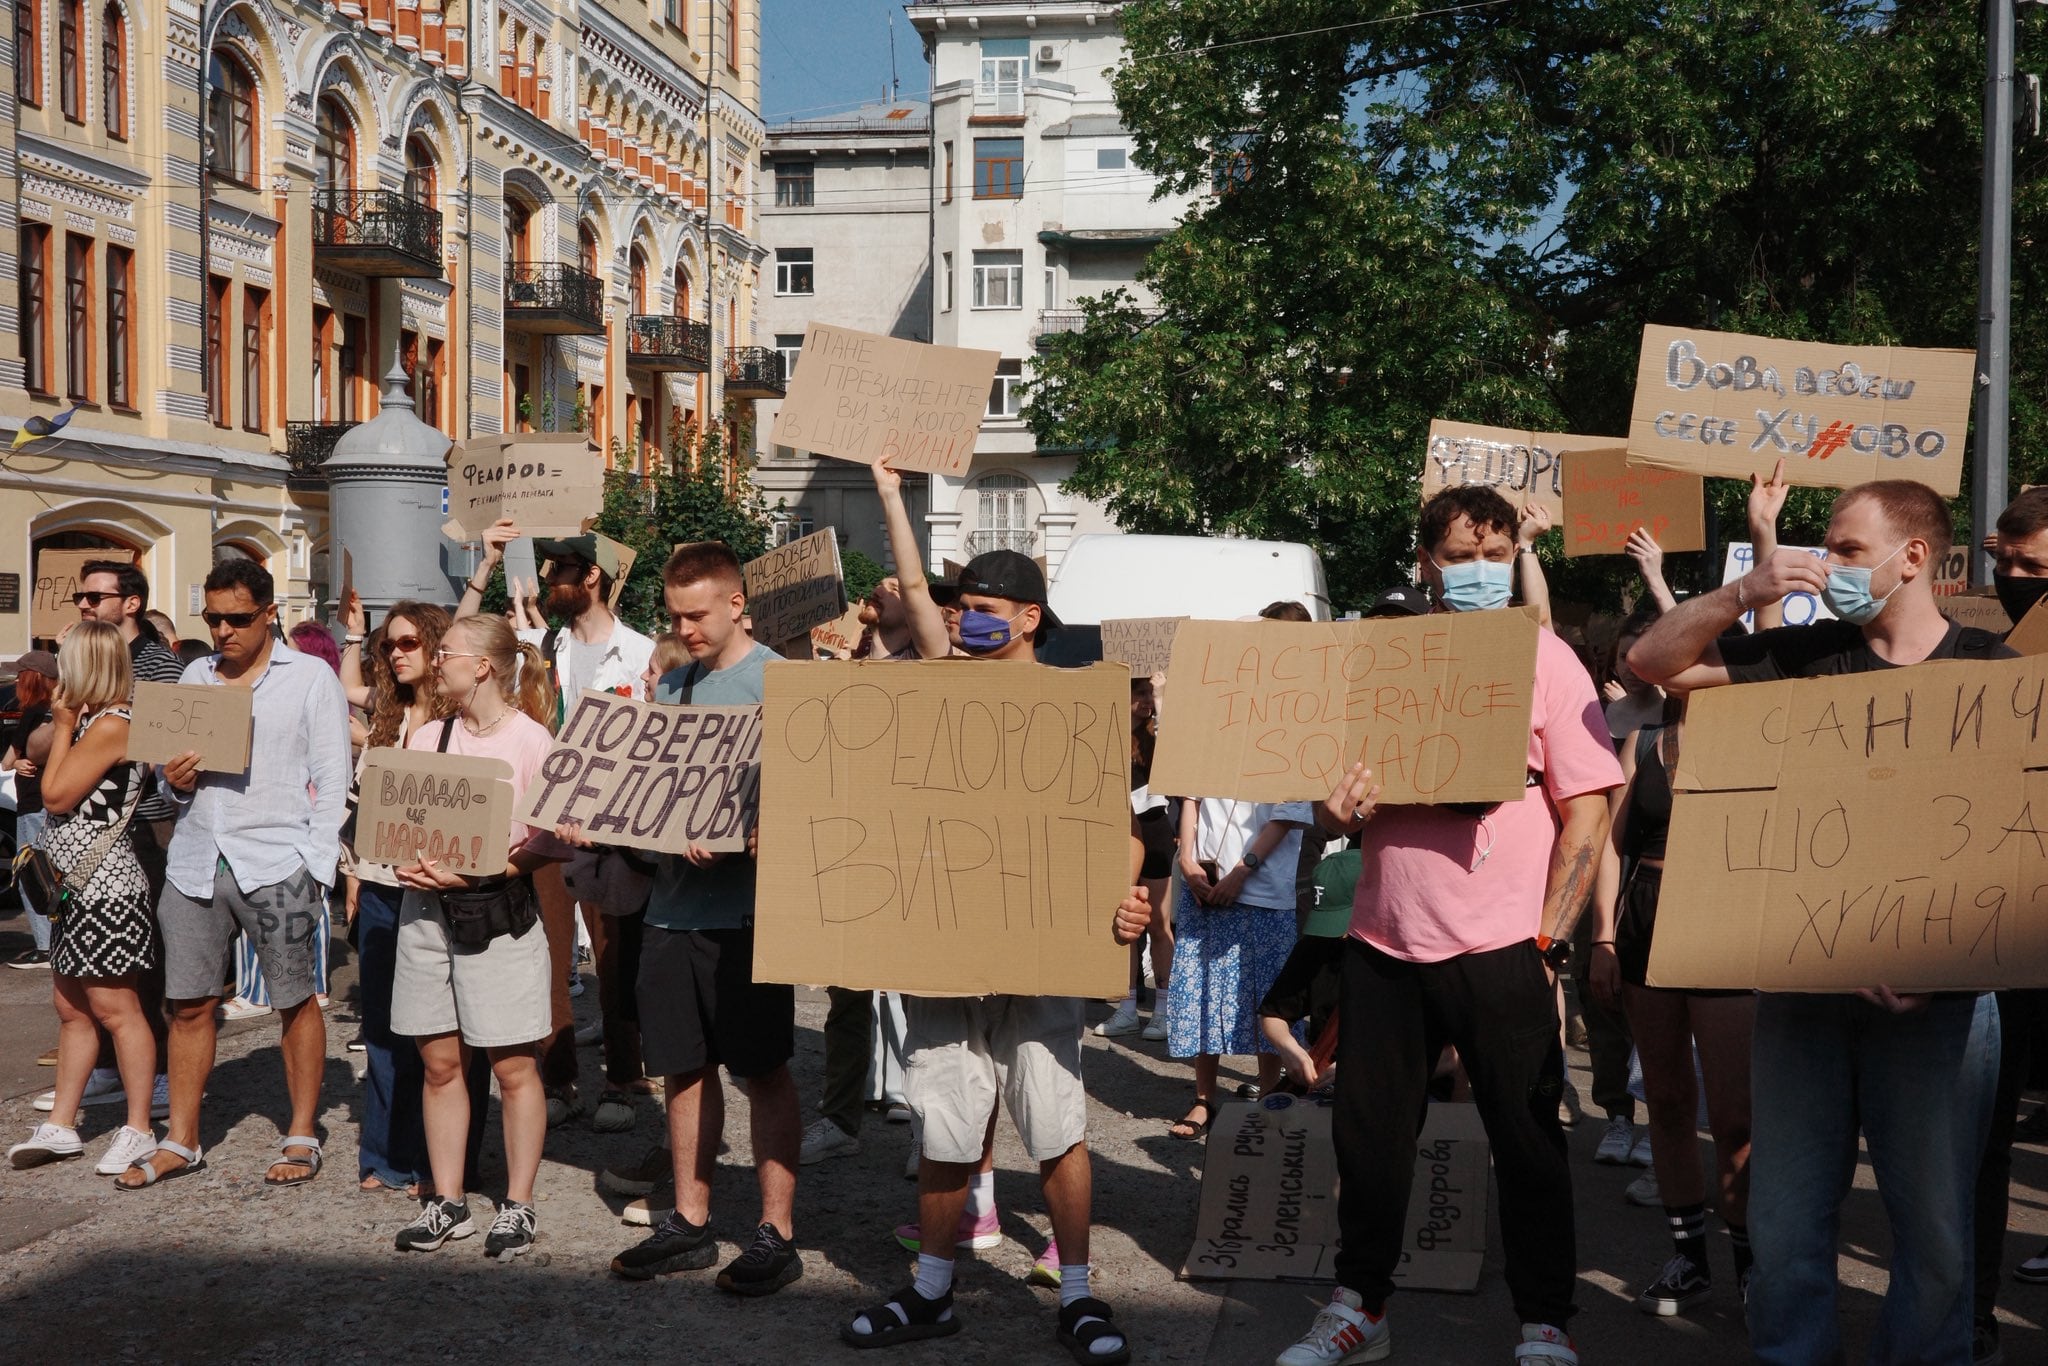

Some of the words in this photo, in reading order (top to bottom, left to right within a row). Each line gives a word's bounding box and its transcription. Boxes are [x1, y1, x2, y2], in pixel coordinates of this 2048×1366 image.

[811, 330, 877, 363] ПАНЕ
[782, 413, 800, 438] В
[811, 418, 869, 454] ЦІЙ
[881, 428, 974, 469] ВІЙНІ?
[837, 396, 868, 421] ВИ
[874, 405, 900, 425] ЗА
[913, 411, 966, 432] КОГО
[750, 557, 771, 585] НАС
[772, 535, 827, 574] ДОВЕЛИ
[1202, 633, 1460, 686] LACTOSE
[1219, 673, 1521, 731] INTOLERANCE
[785, 684, 1129, 810] ФЕДОРОВА
[1242, 728, 1461, 794] SQUAD
[406, 807, 426, 825] ЦЕ
[1726, 800, 1850, 872] ШО
[1932, 795, 2048, 861] ЗА
[375, 821, 482, 869] НАРОД!
[809, 810, 1114, 936] ВИРНІТ
[1256, 1127, 1307, 1257] Зеленський
[1417, 1139, 1463, 1251] Федорова
